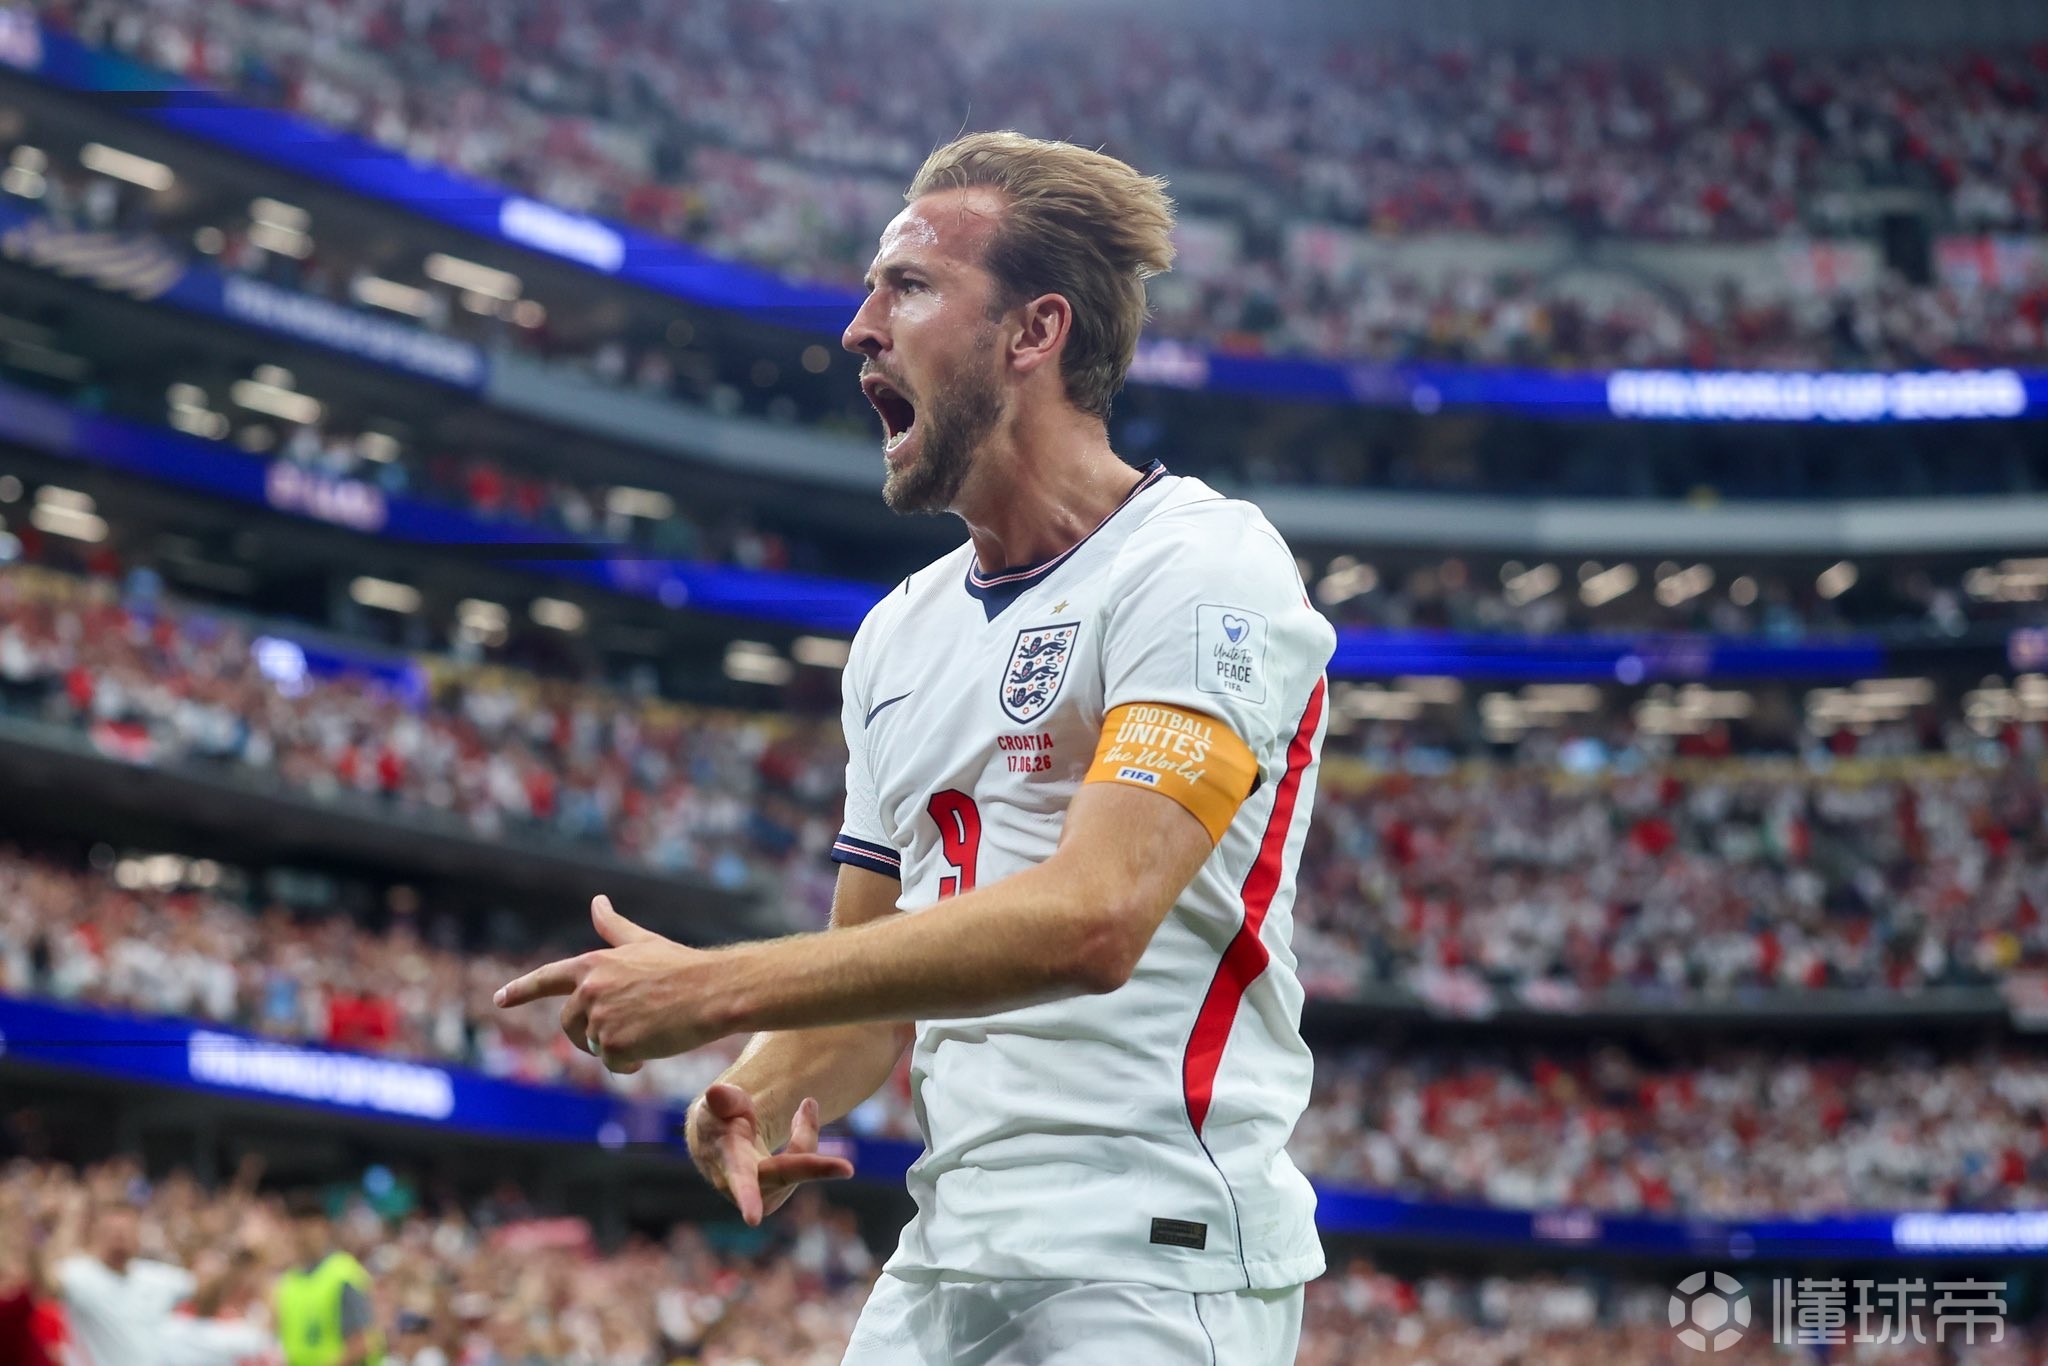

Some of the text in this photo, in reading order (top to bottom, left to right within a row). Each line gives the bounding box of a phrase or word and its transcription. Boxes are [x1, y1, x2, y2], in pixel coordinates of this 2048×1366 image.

[1213, 643, 1240, 661] Unite
[1216, 660, 1253, 684] PEACE
[1223, 680, 1242, 692] FIFA
[1125, 705, 1213, 745] FOOTBALL
[996, 732, 1054, 751] CROATIA
[1115, 722, 1211, 763] UNITES
[1007, 754, 1053, 773] 17.06.26
[1102, 743, 1206, 786] the World
[1120, 768, 1155, 784] FIFA
[927, 788, 982, 903] 9
